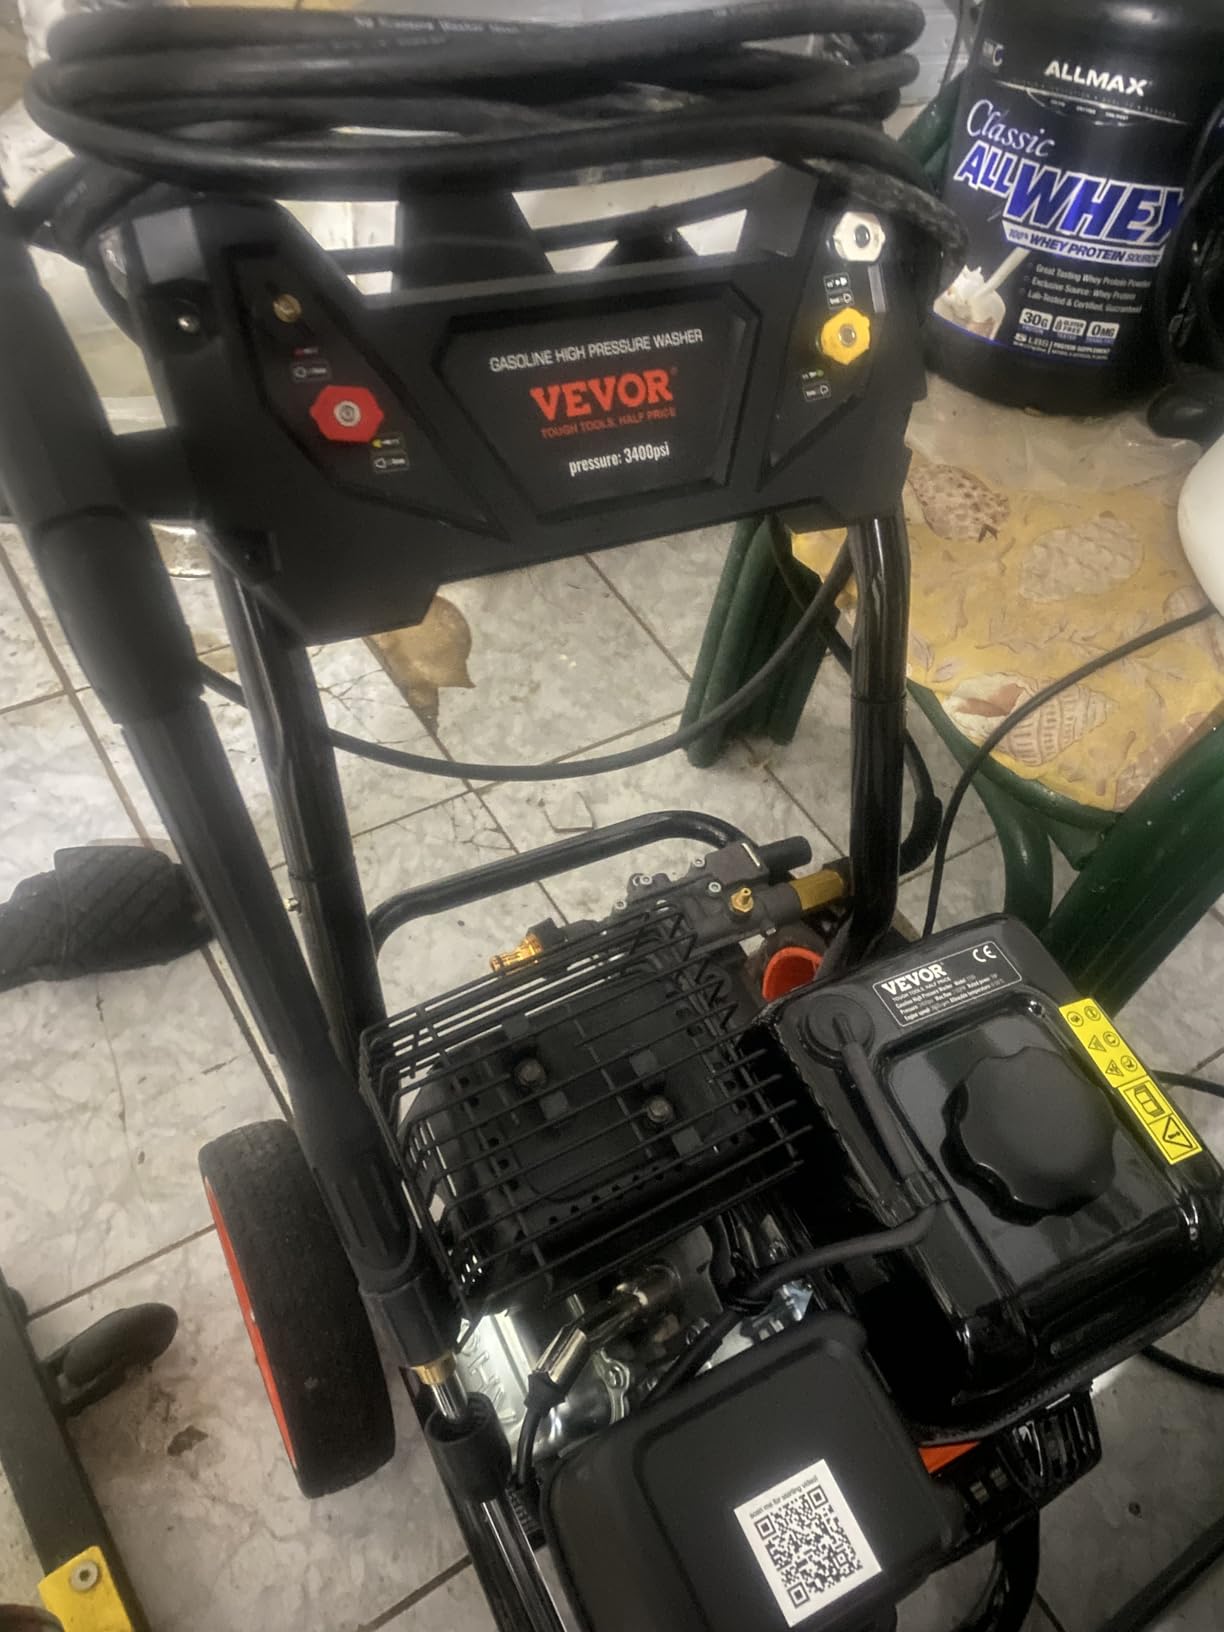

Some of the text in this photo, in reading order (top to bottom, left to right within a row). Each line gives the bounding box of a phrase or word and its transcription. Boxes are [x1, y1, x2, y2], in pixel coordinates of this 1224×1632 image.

[1044, 60, 1147, 97] ALLMAX
[967, 99, 1055, 157] Classic
[1029, 233, 1068, 252] WHEY
[1067, 243, 1125, 262] PROTEIN
[1125, 253, 1160, 264] SOURCE
[1023, 311, 1048, 328] 30G
[1091, 324, 1115, 337] 0MG
[489, 328, 704, 373] GASOLINE HIGH PRESSURE WASHER
[529, 368, 674, 421] VEVOR
[541, 421, 579, 439] TOUGH
[619, 413, 645, 425] HALF
[647, 407, 677, 420] PRICE
[569, 441, 670, 477] pressure: 3400psi
[881, 963, 948, 995] VEVOR
